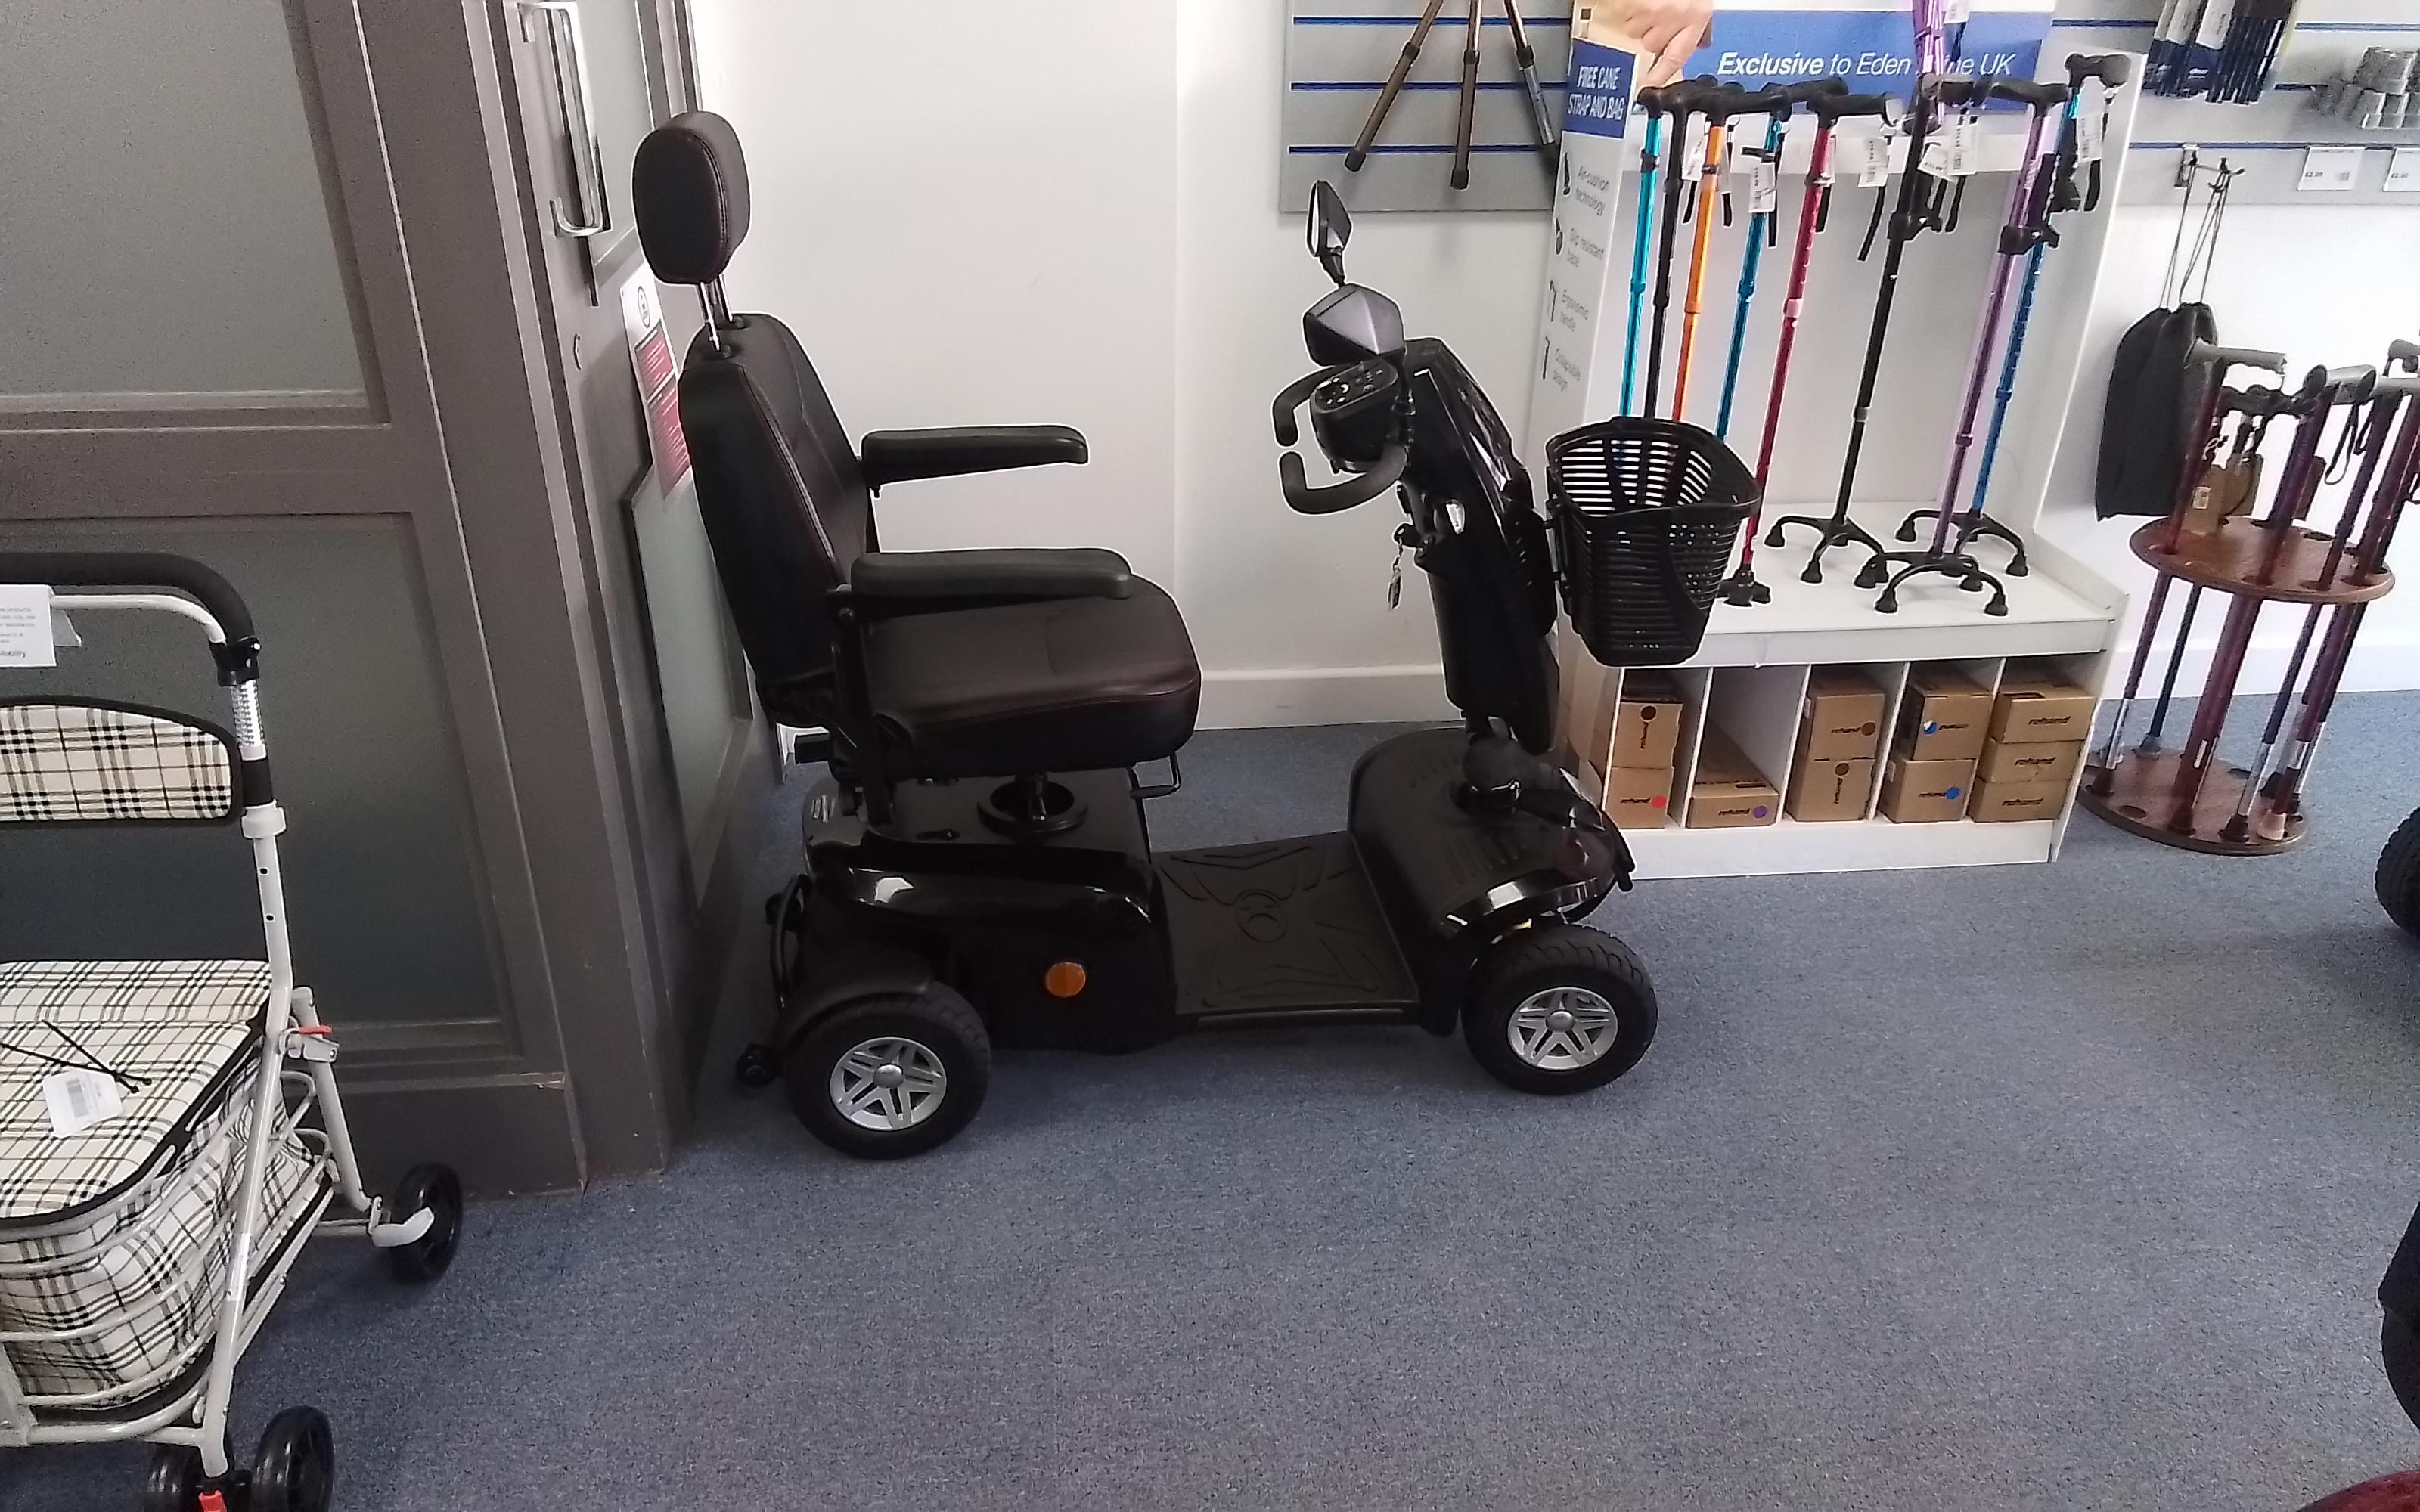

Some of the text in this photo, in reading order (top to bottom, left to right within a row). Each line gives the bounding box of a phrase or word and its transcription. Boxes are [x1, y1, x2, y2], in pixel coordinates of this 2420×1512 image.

[1717, 51, 1824, 75] Exclusive
[1829, 54, 1851, 75] to
[1856, 52, 1912, 75] Eden
[1981, 53, 2016, 75] UK
[1577, 65, 1621, 90] FREE CANE
[1567, 93, 1625, 120] STRAP AND BAG
